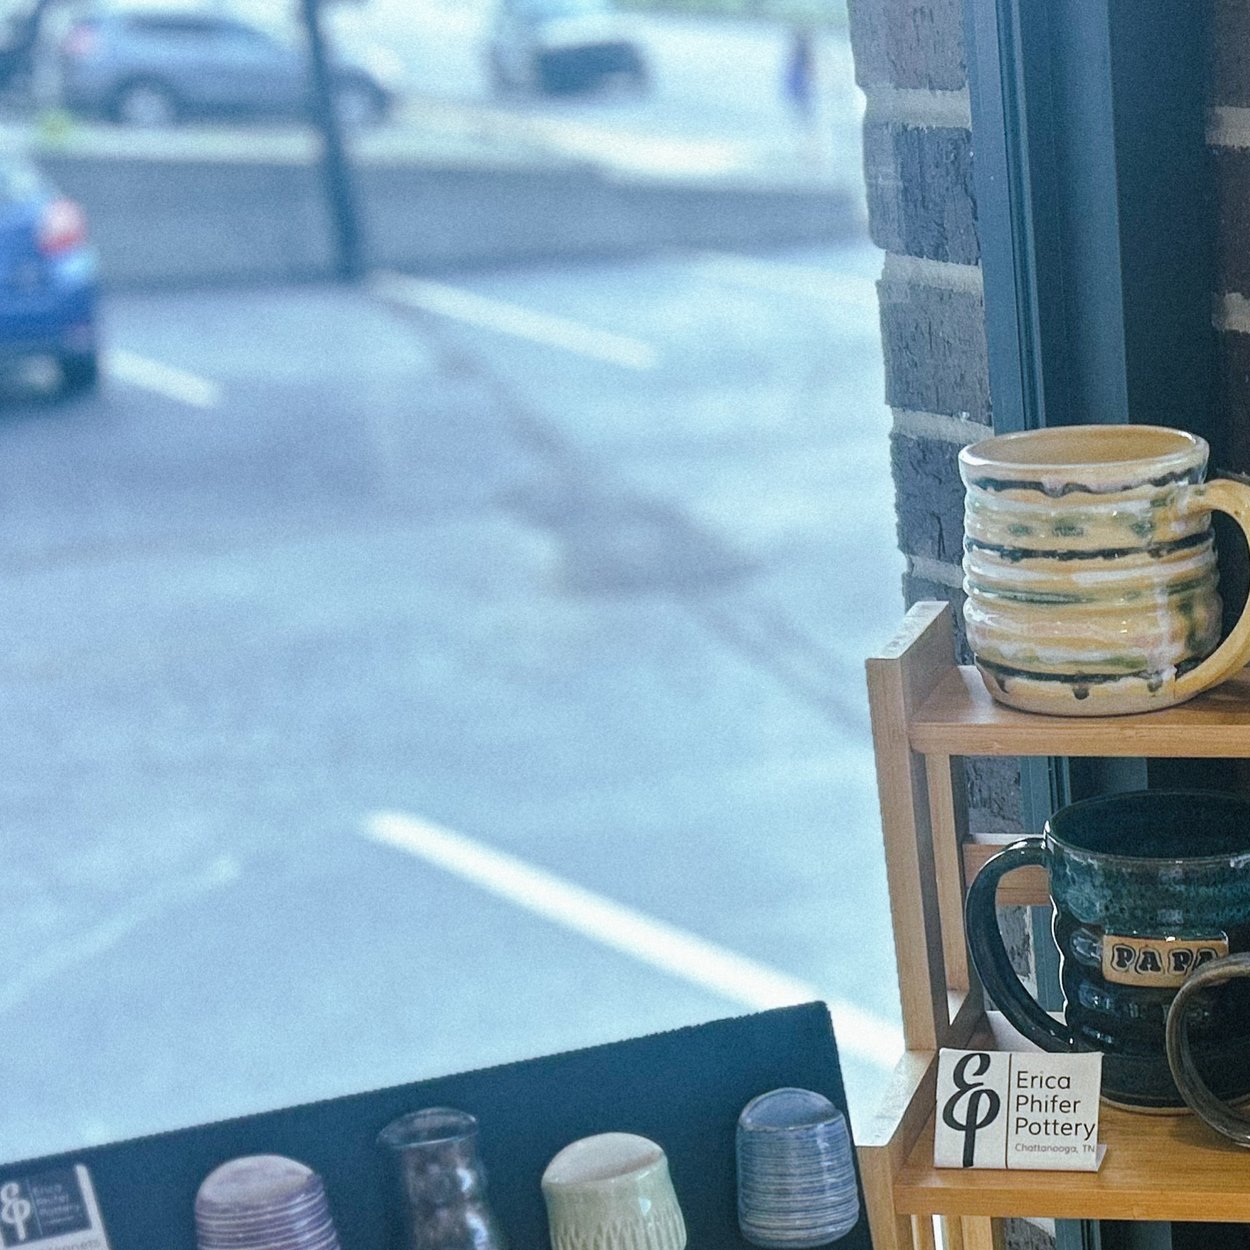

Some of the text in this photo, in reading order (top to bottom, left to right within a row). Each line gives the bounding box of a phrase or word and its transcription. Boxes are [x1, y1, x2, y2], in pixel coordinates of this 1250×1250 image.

[1016, 1070, 1071, 1090] Erica
[1015, 1094, 1081, 1114] Phifer
[1014, 1117, 1096, 1141] Pottery
[1014, 1143, 1095, 1155] Chattanooga, TN
